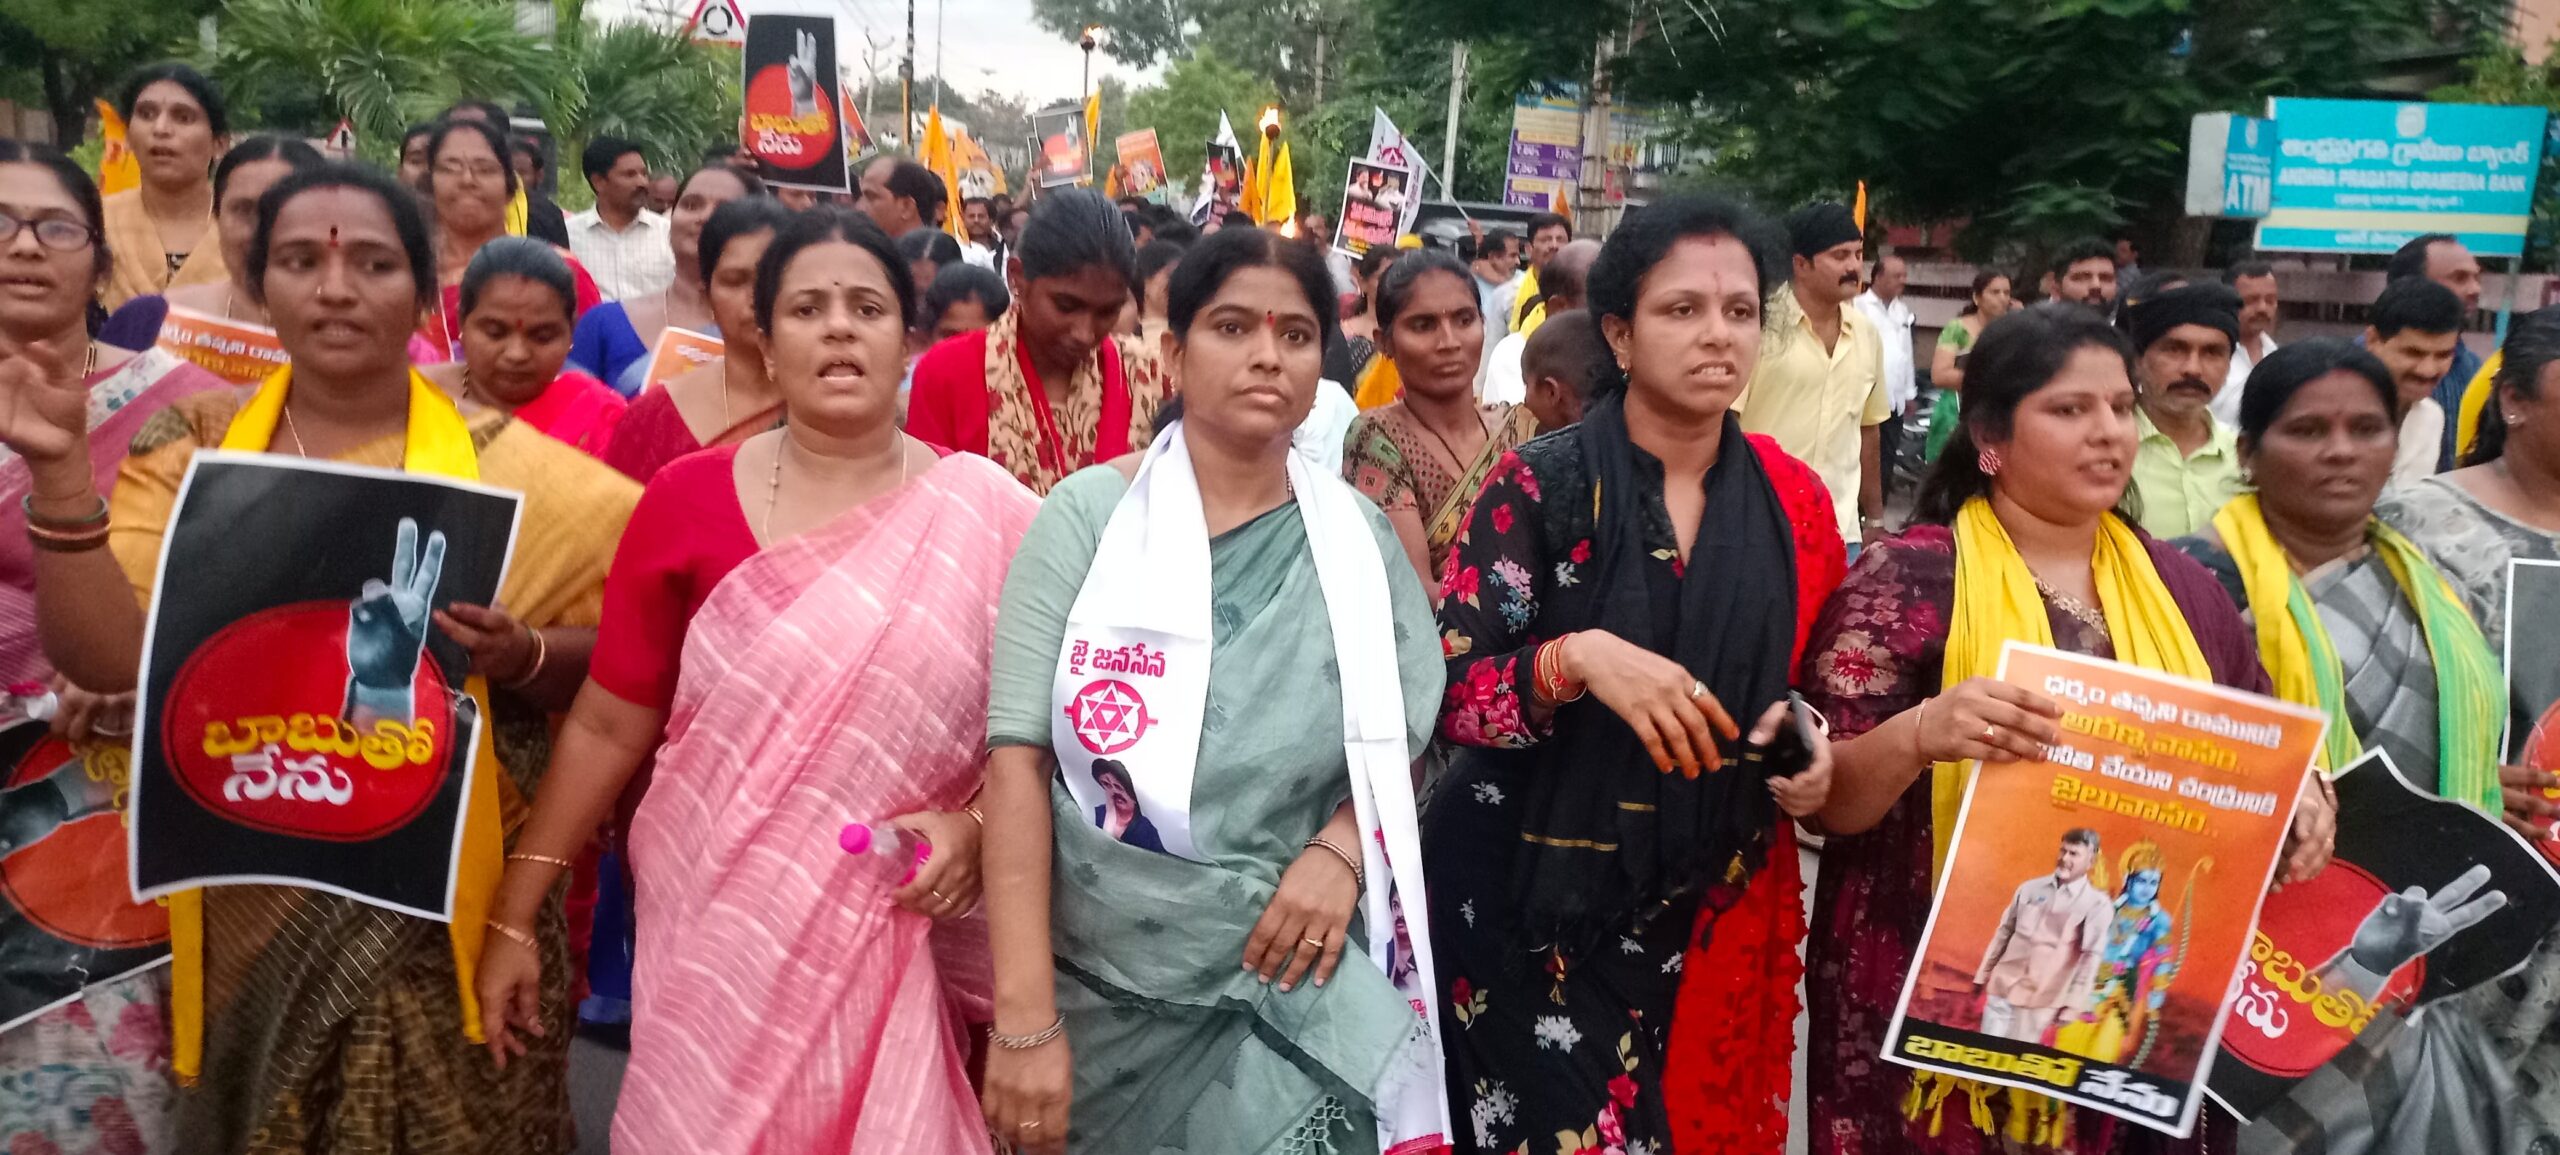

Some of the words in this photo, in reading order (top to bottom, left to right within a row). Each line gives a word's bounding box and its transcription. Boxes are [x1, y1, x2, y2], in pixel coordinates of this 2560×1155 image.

[2225, 172, 2271, 213] ATM
[2488, 173, 2526, 192] BANK
[1070, 640, 1090, 676] జై
[1092, 642, 1166, 678] జనసేన
[2044, 675, 2106, 707] ధర్మం
[2111, 690, 2178, 723] తప్పని
[203, 712, 435, 770] బాబుతో
[223, 743, 353, 806] నేను
[2101, 754, 2173, 792] చేయని
[1904, 1034, 2084, 1088] బాబుతో
[2078, 1068, 2180, 1118] నేను
